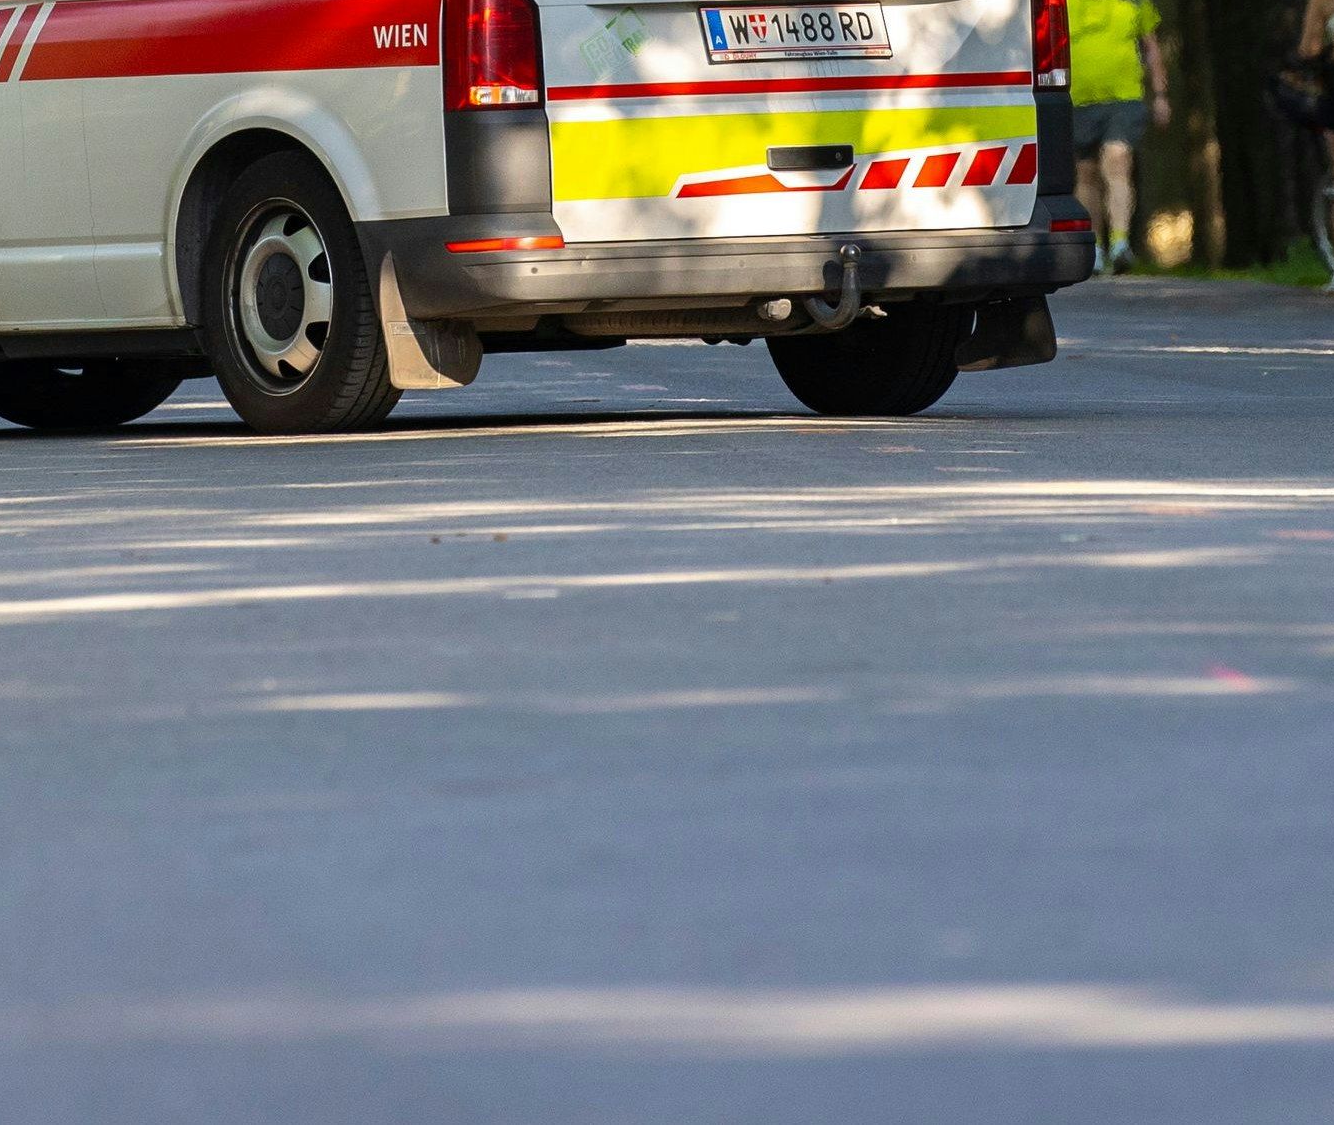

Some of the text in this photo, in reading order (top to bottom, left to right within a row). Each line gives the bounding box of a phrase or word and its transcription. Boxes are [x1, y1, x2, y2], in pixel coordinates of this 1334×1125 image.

[373, 23, 428, 49] WIEN
[714, 35, 724, 46] A
[729, 11, 874, 45] W 1488 RD
